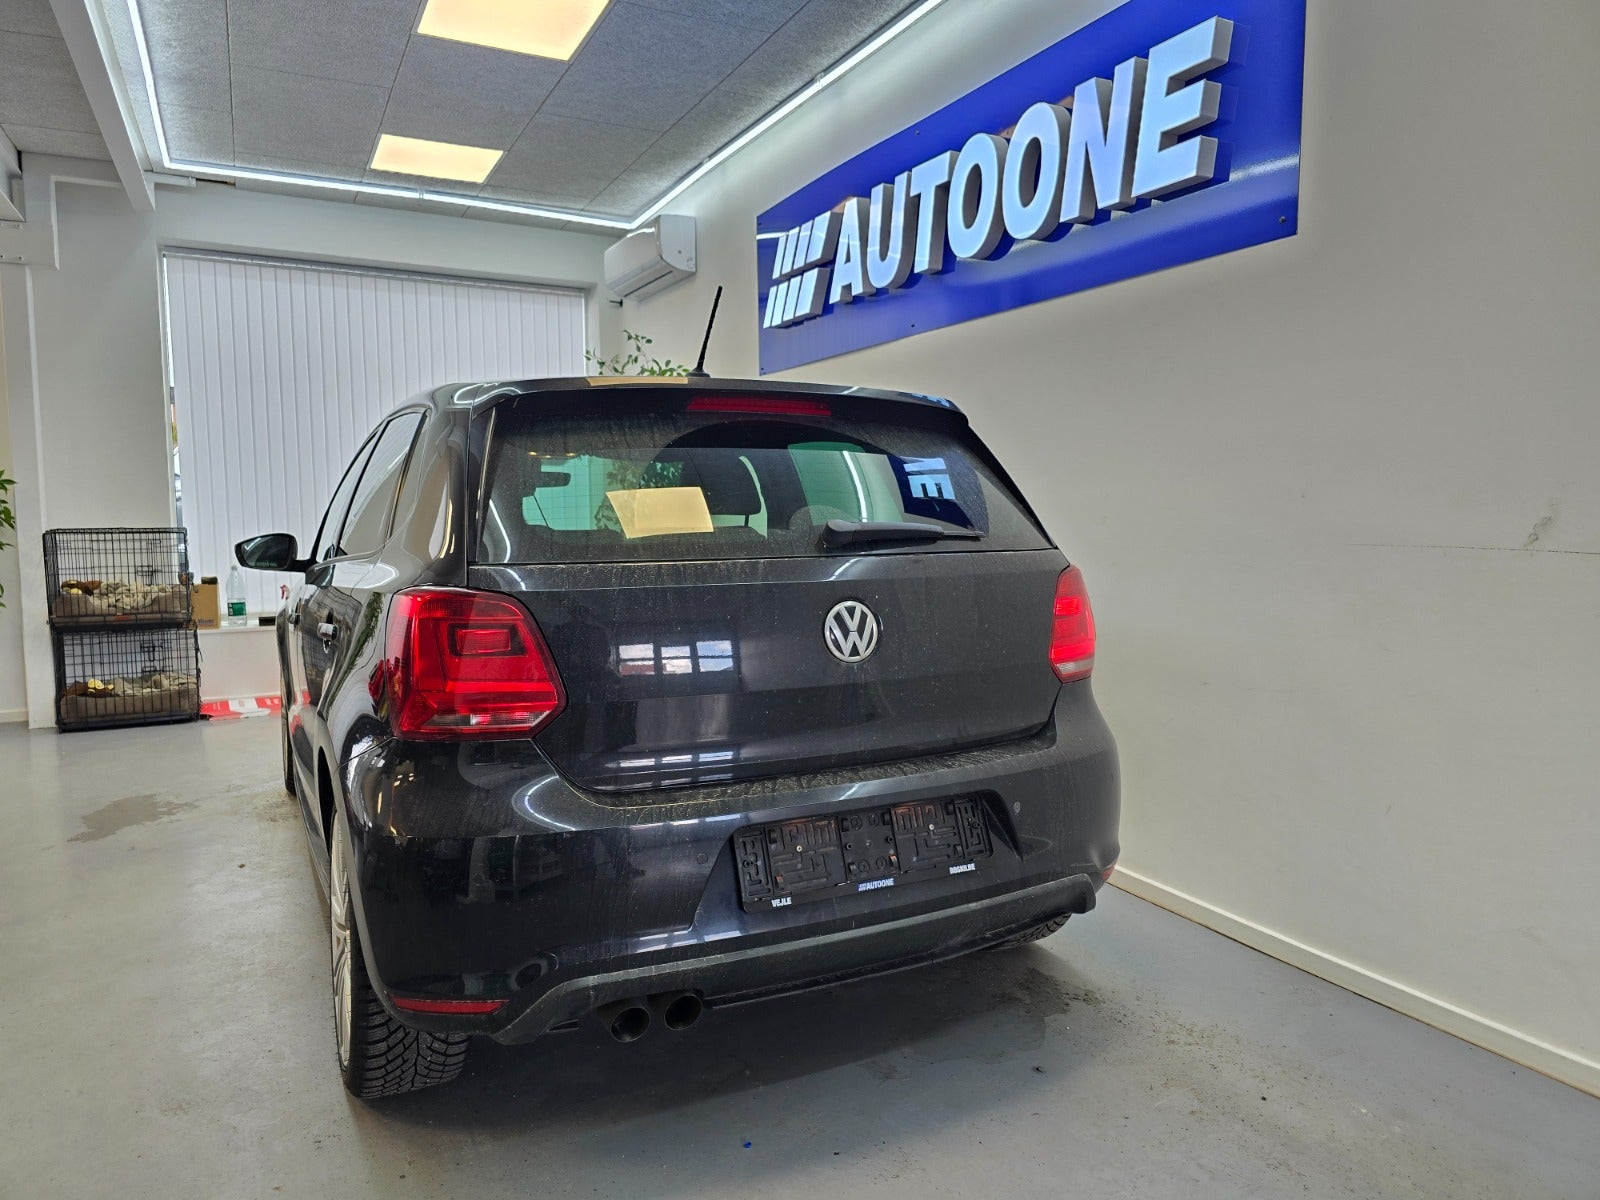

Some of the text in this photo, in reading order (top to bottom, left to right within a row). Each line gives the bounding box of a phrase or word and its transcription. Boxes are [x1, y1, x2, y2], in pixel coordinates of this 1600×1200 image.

[829, 15, 1232, 304] AUTOONE
[866, 877, 894, 890] AUTOONE
[771, 896, 792, 908] VEJLE
